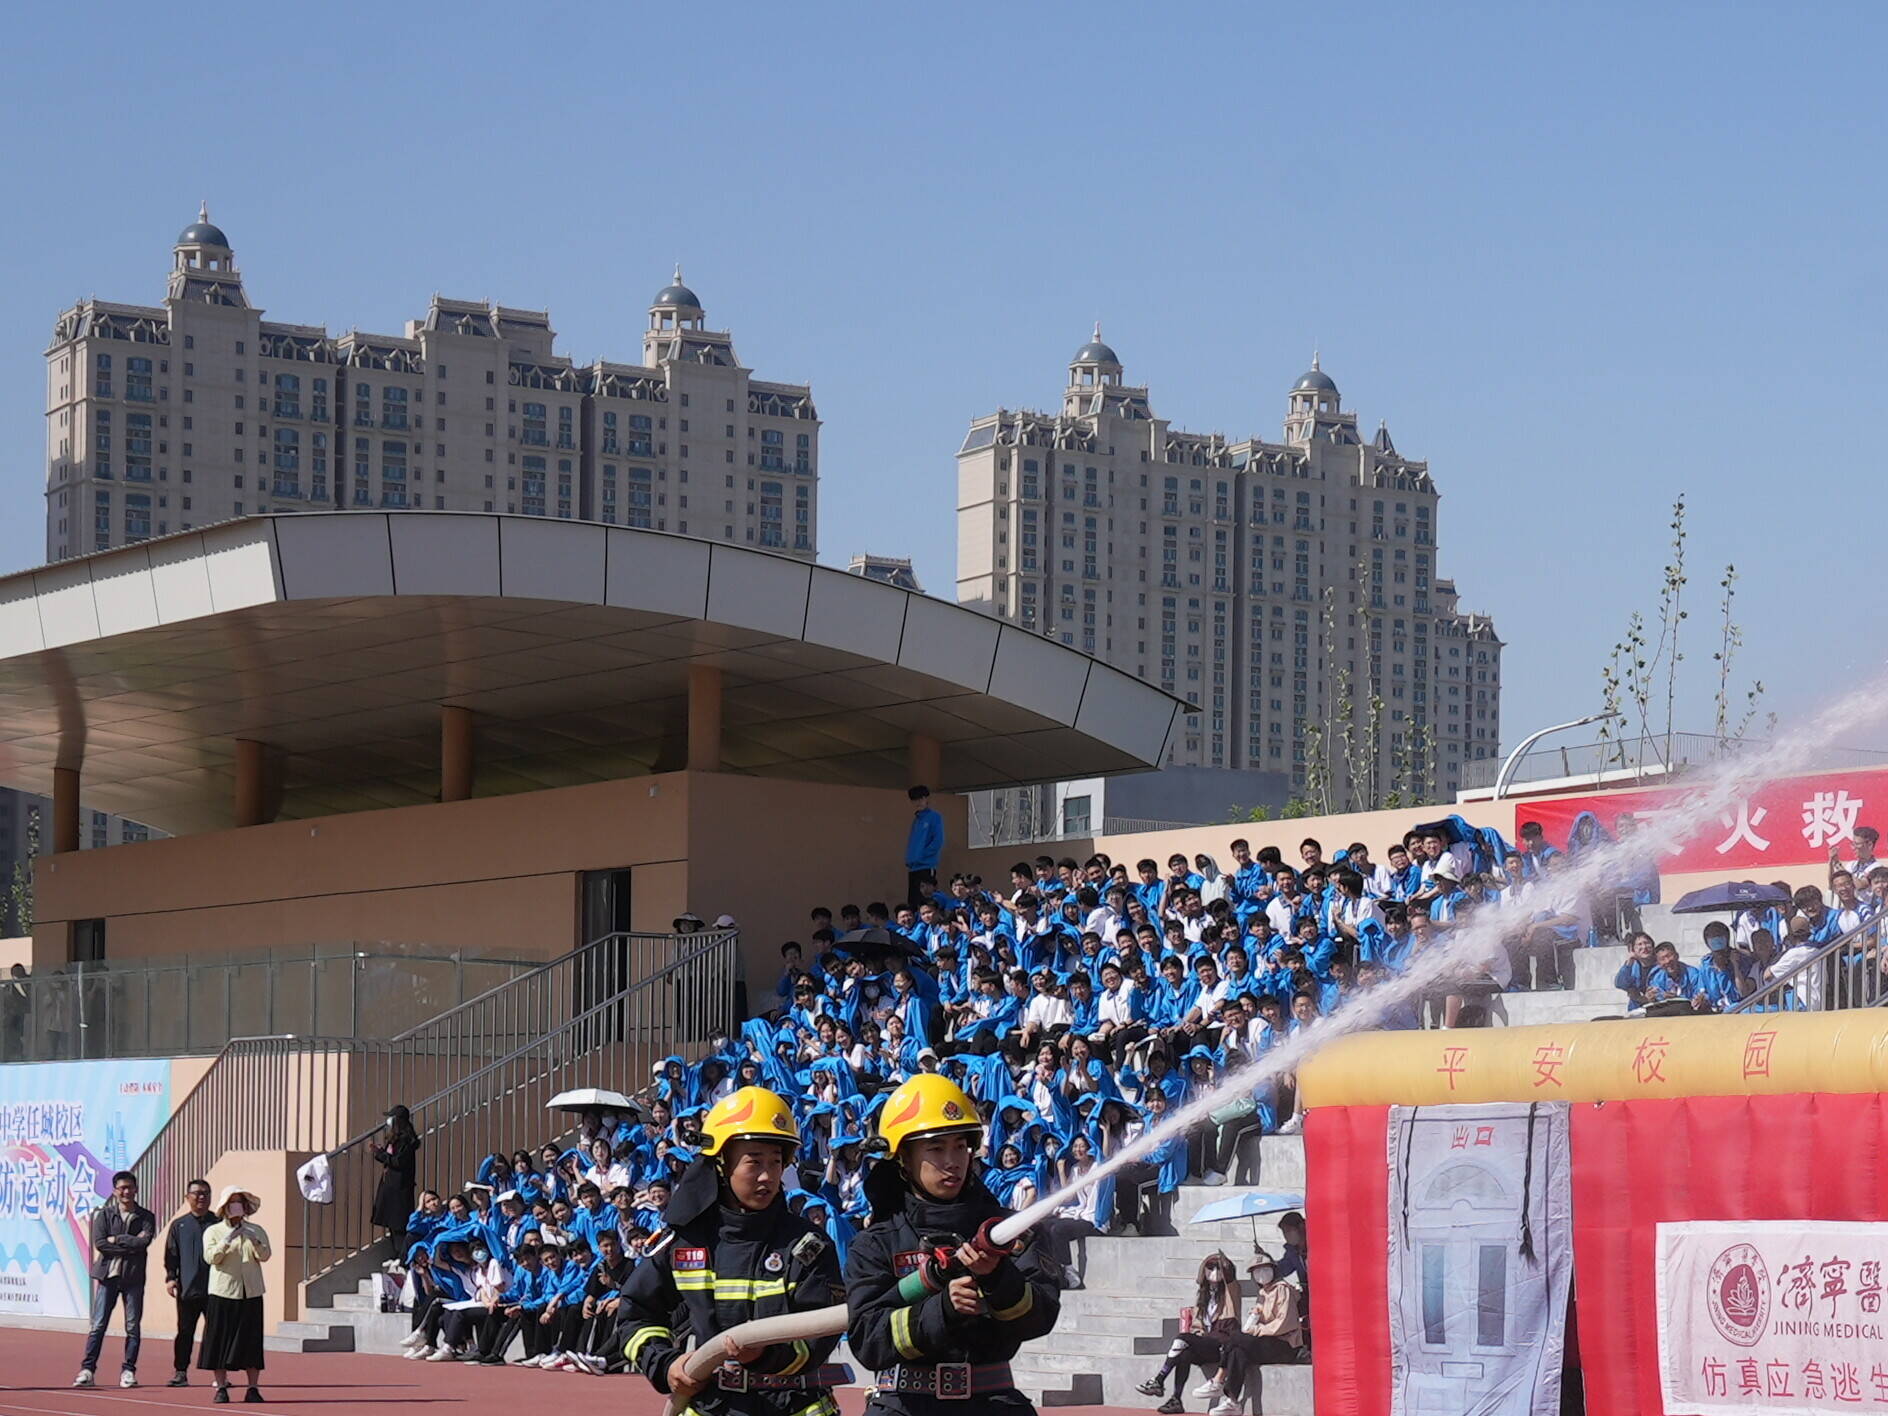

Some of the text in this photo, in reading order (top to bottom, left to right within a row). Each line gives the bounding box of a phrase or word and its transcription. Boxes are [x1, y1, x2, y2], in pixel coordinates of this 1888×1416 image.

[1436, 1030, 1777, 1091] 平安校园
[0, 1103, 82, 1141] 中学任城校区
[1451, 1125, 1494, 1150] 出口
[686, 1250, 704, 1261] 119
[1774, 1321, 1820, 1336] JINING
[1823, 1323, 1883, 1340] MEDICAL
